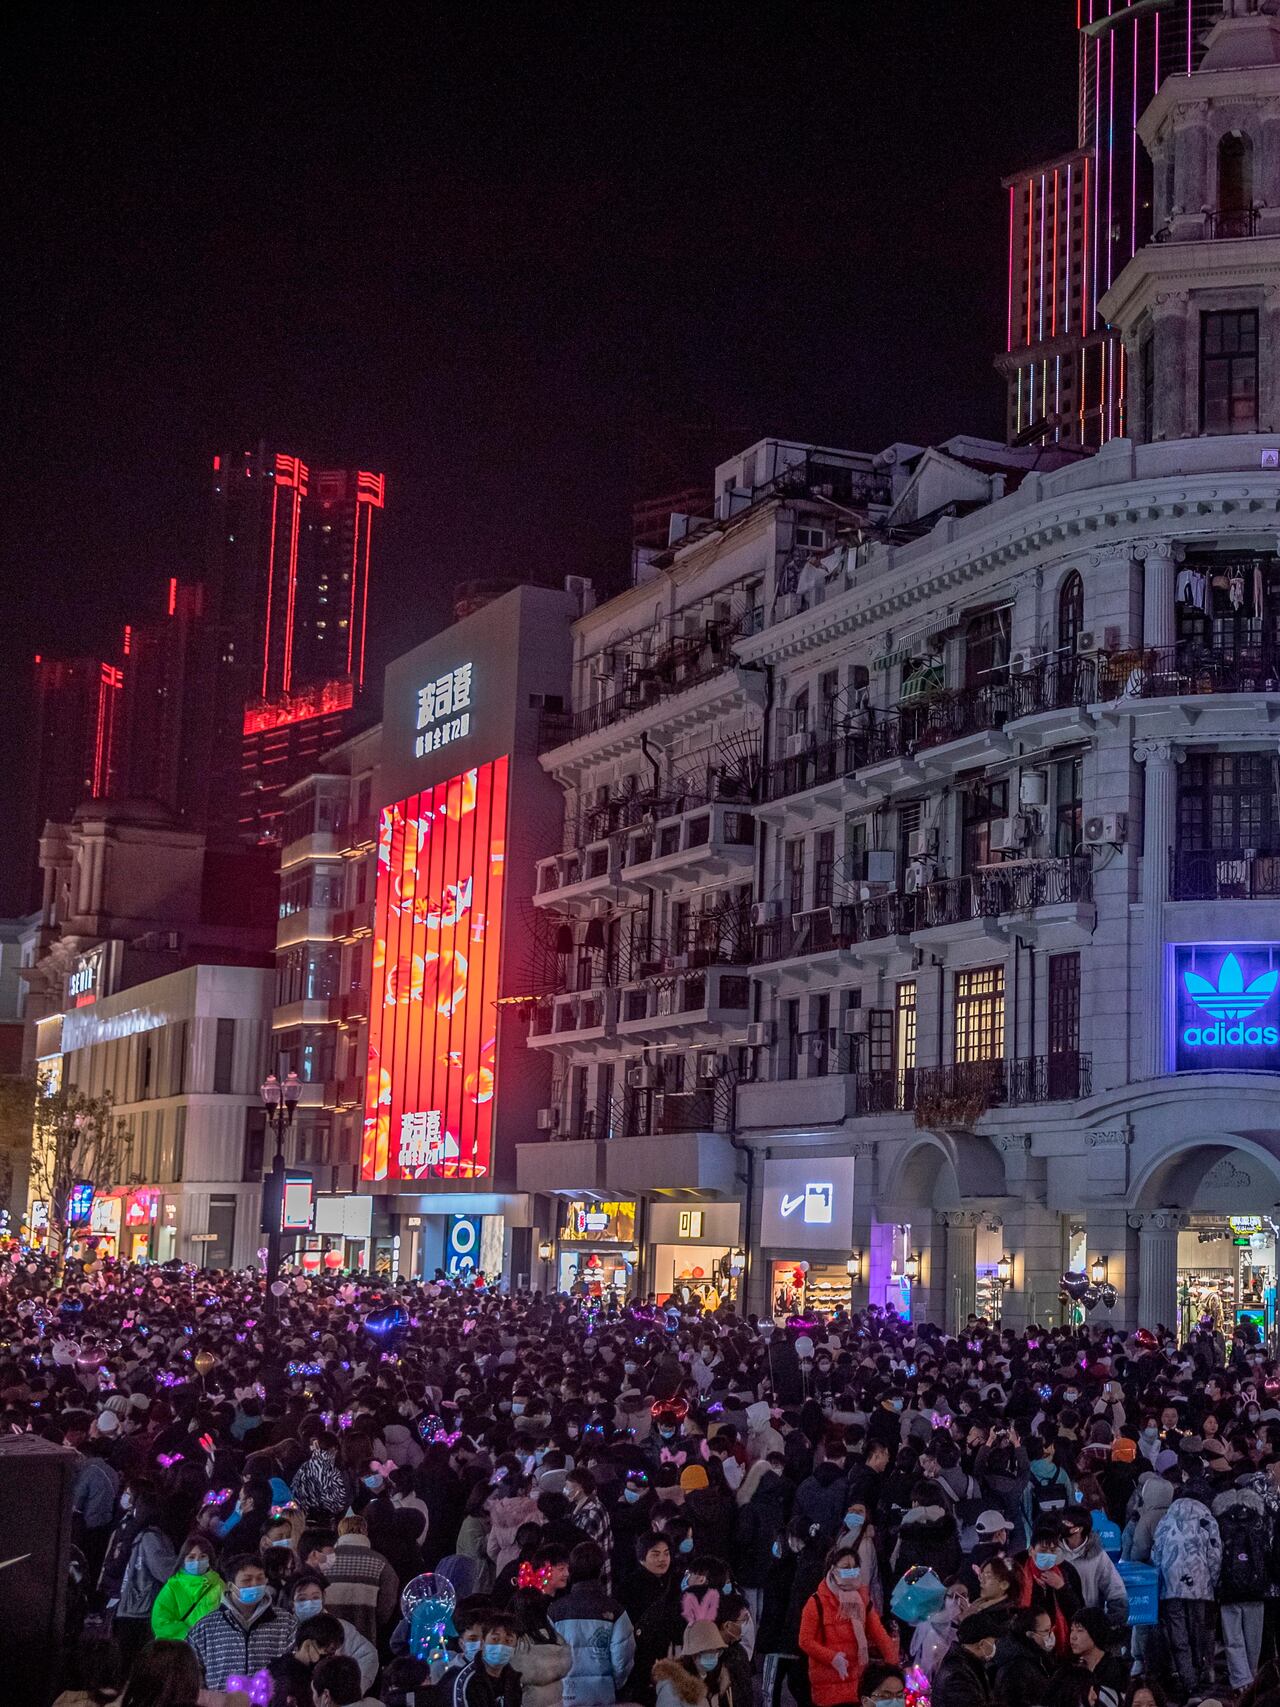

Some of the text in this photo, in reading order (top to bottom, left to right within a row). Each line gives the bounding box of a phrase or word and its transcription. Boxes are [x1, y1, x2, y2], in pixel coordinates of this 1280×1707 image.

[417, 662, 473, 730] 波司登
[1183, 1022, 1279, 1046] adidas
